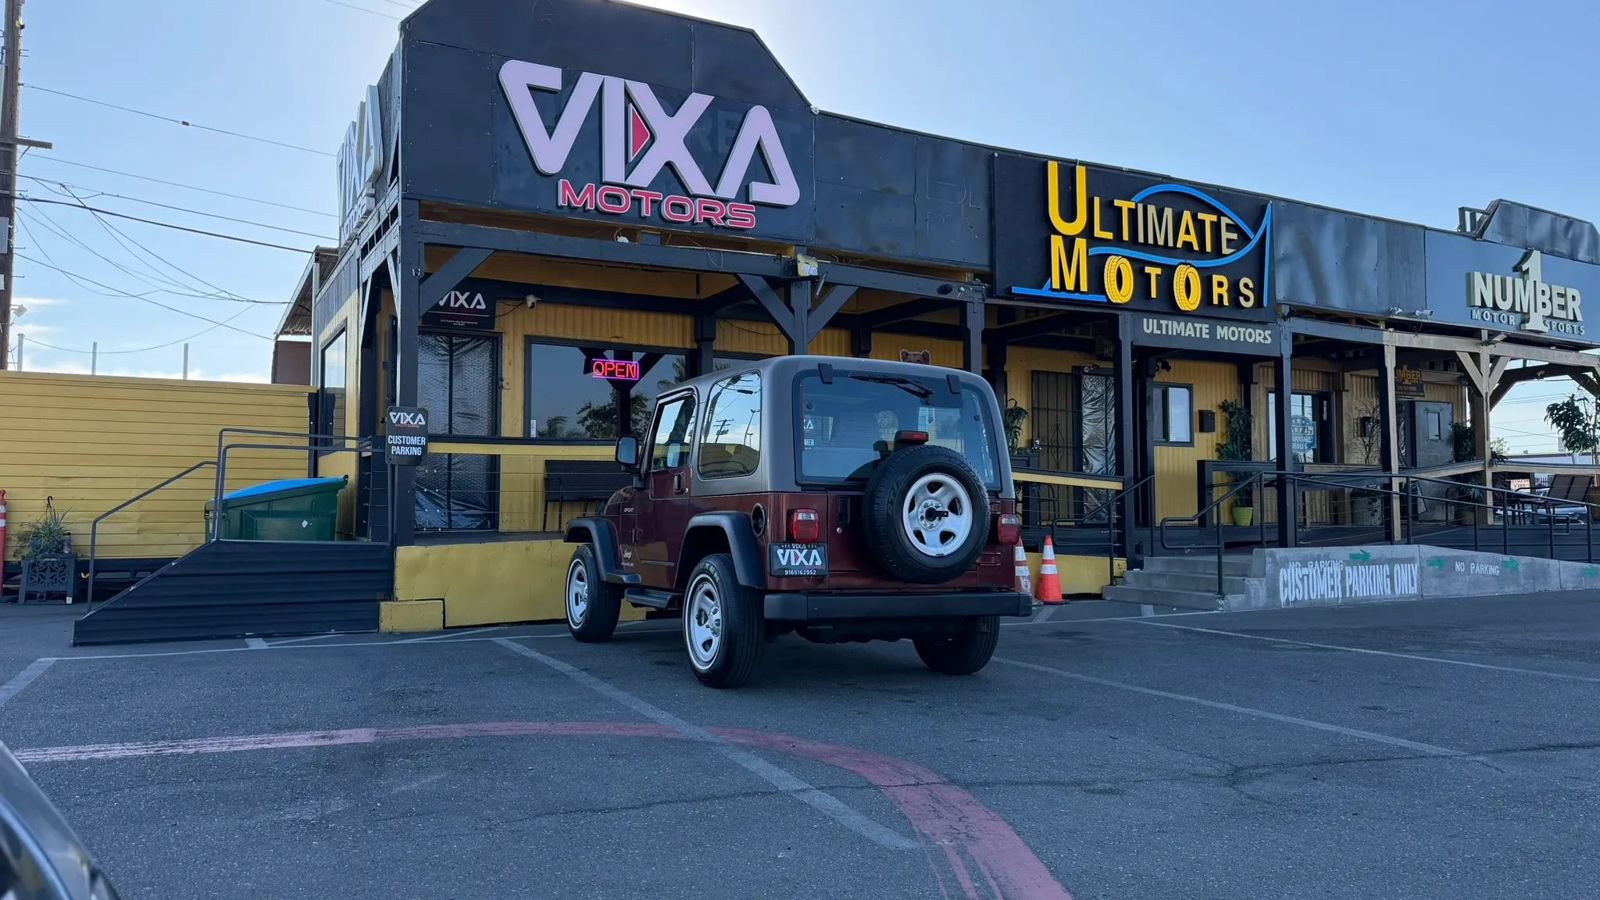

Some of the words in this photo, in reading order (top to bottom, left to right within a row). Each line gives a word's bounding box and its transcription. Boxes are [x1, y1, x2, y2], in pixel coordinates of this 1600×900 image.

[498, 59, 800, 207] VIXA
[557, 178, 756, 229] MOTORS
[1047, 160, 1239, 256] ULTIMATE
[1050, 234, 1255, 312] MOTORS
[1466, 271, 1583, 322] NUMBER
[1142, 318, 1210, 339] ULTIMATE
[1216, 326, 1272, 344] MOTORS
[1471, 309, 1516, 326] MOTOR
[1543, 319, 1585, 336] SPORTS
[592, 361, 637, 378] OPEN
[389, 411, 426, 425] VIXA
[388, 435, 426, 446] CUSTOMER
[391, 446, 422, 456] PARKING
[776, 549, 822, 566] VIXA
[1455, 561, 1465, 572] NO
[1470, 563, 1500, 576] PARKING
[1280, 566, 1342, 602] CUSTOMER
[1345, 565, 1392, 597] PARKING
[1393, 563, 1418, 595] ONLY
